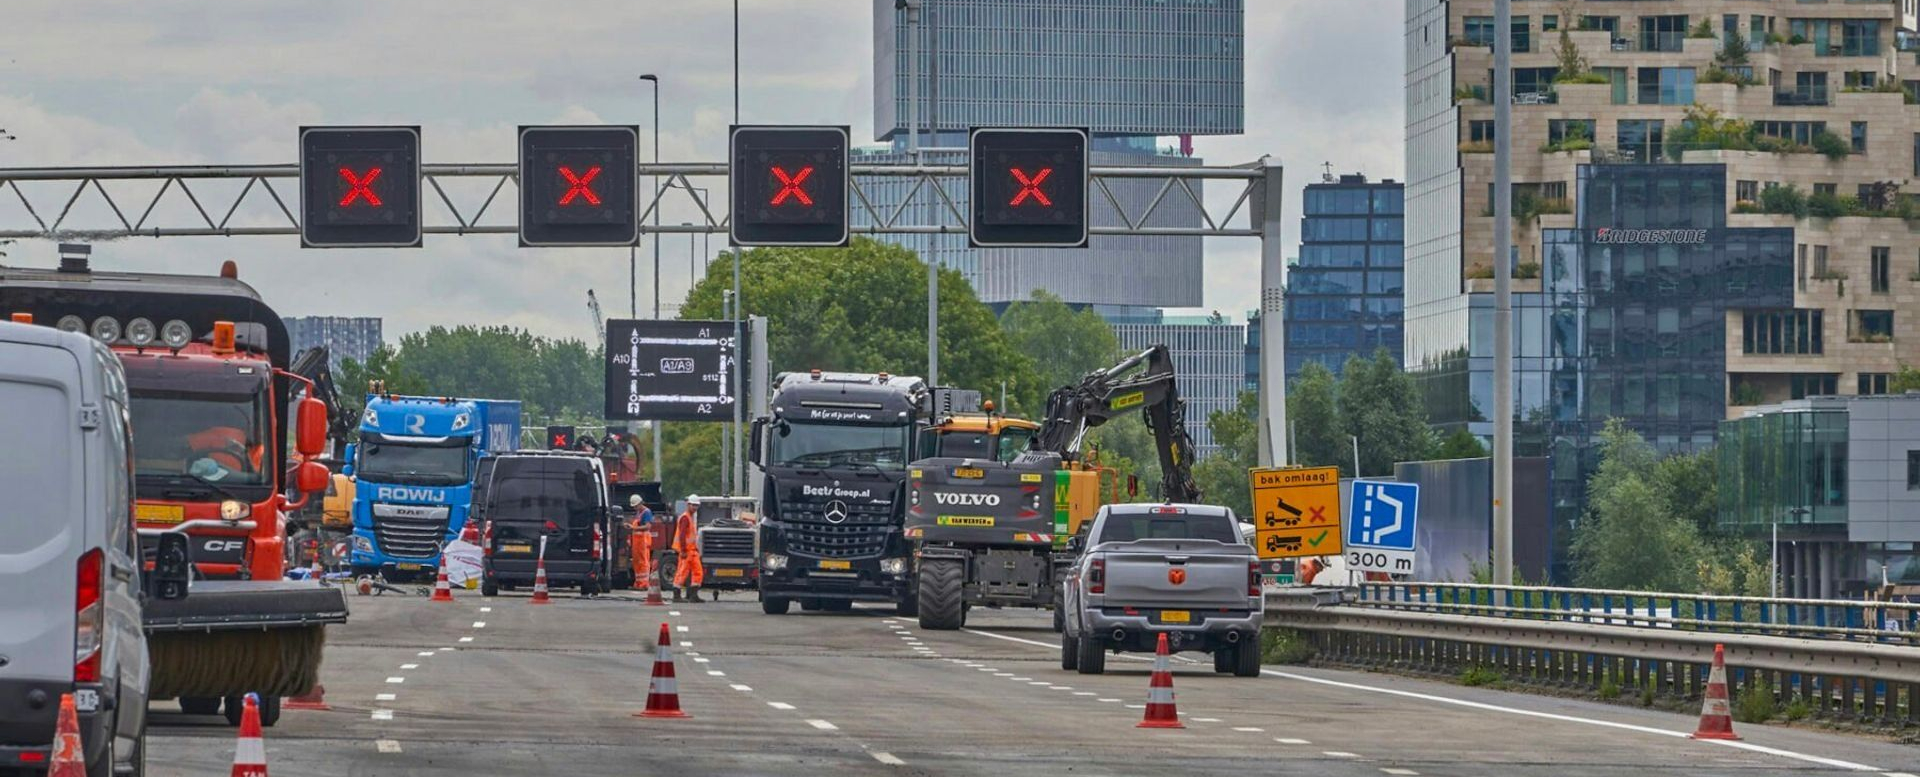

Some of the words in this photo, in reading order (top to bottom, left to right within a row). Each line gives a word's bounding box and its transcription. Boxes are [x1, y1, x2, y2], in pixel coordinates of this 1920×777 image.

[1596, 228, 1707, 244] BRIDGESTONE
[698, 328, 710, 338] A1
[613, 353, 631, 365] A10
[663, 360, 693, 371] A1/A9
[697, 404, 712, 414] A2
[1260, 474, 1282, 484] bak
[1285, 471, 1330, 485] omlaag!
[377, 486, 445, 502] ROWIJ
[803, 485, 833, 496] Beets
[834, 487, 871, 499] Groep.nl
[933, 492, 1000, 506] VOLVO
[396, 508, 425, 516] DAF
[203, 540, 243, 552] CF
[1349, 552, 1387, 568] 300
[1395, 559, 1412, 570] m
